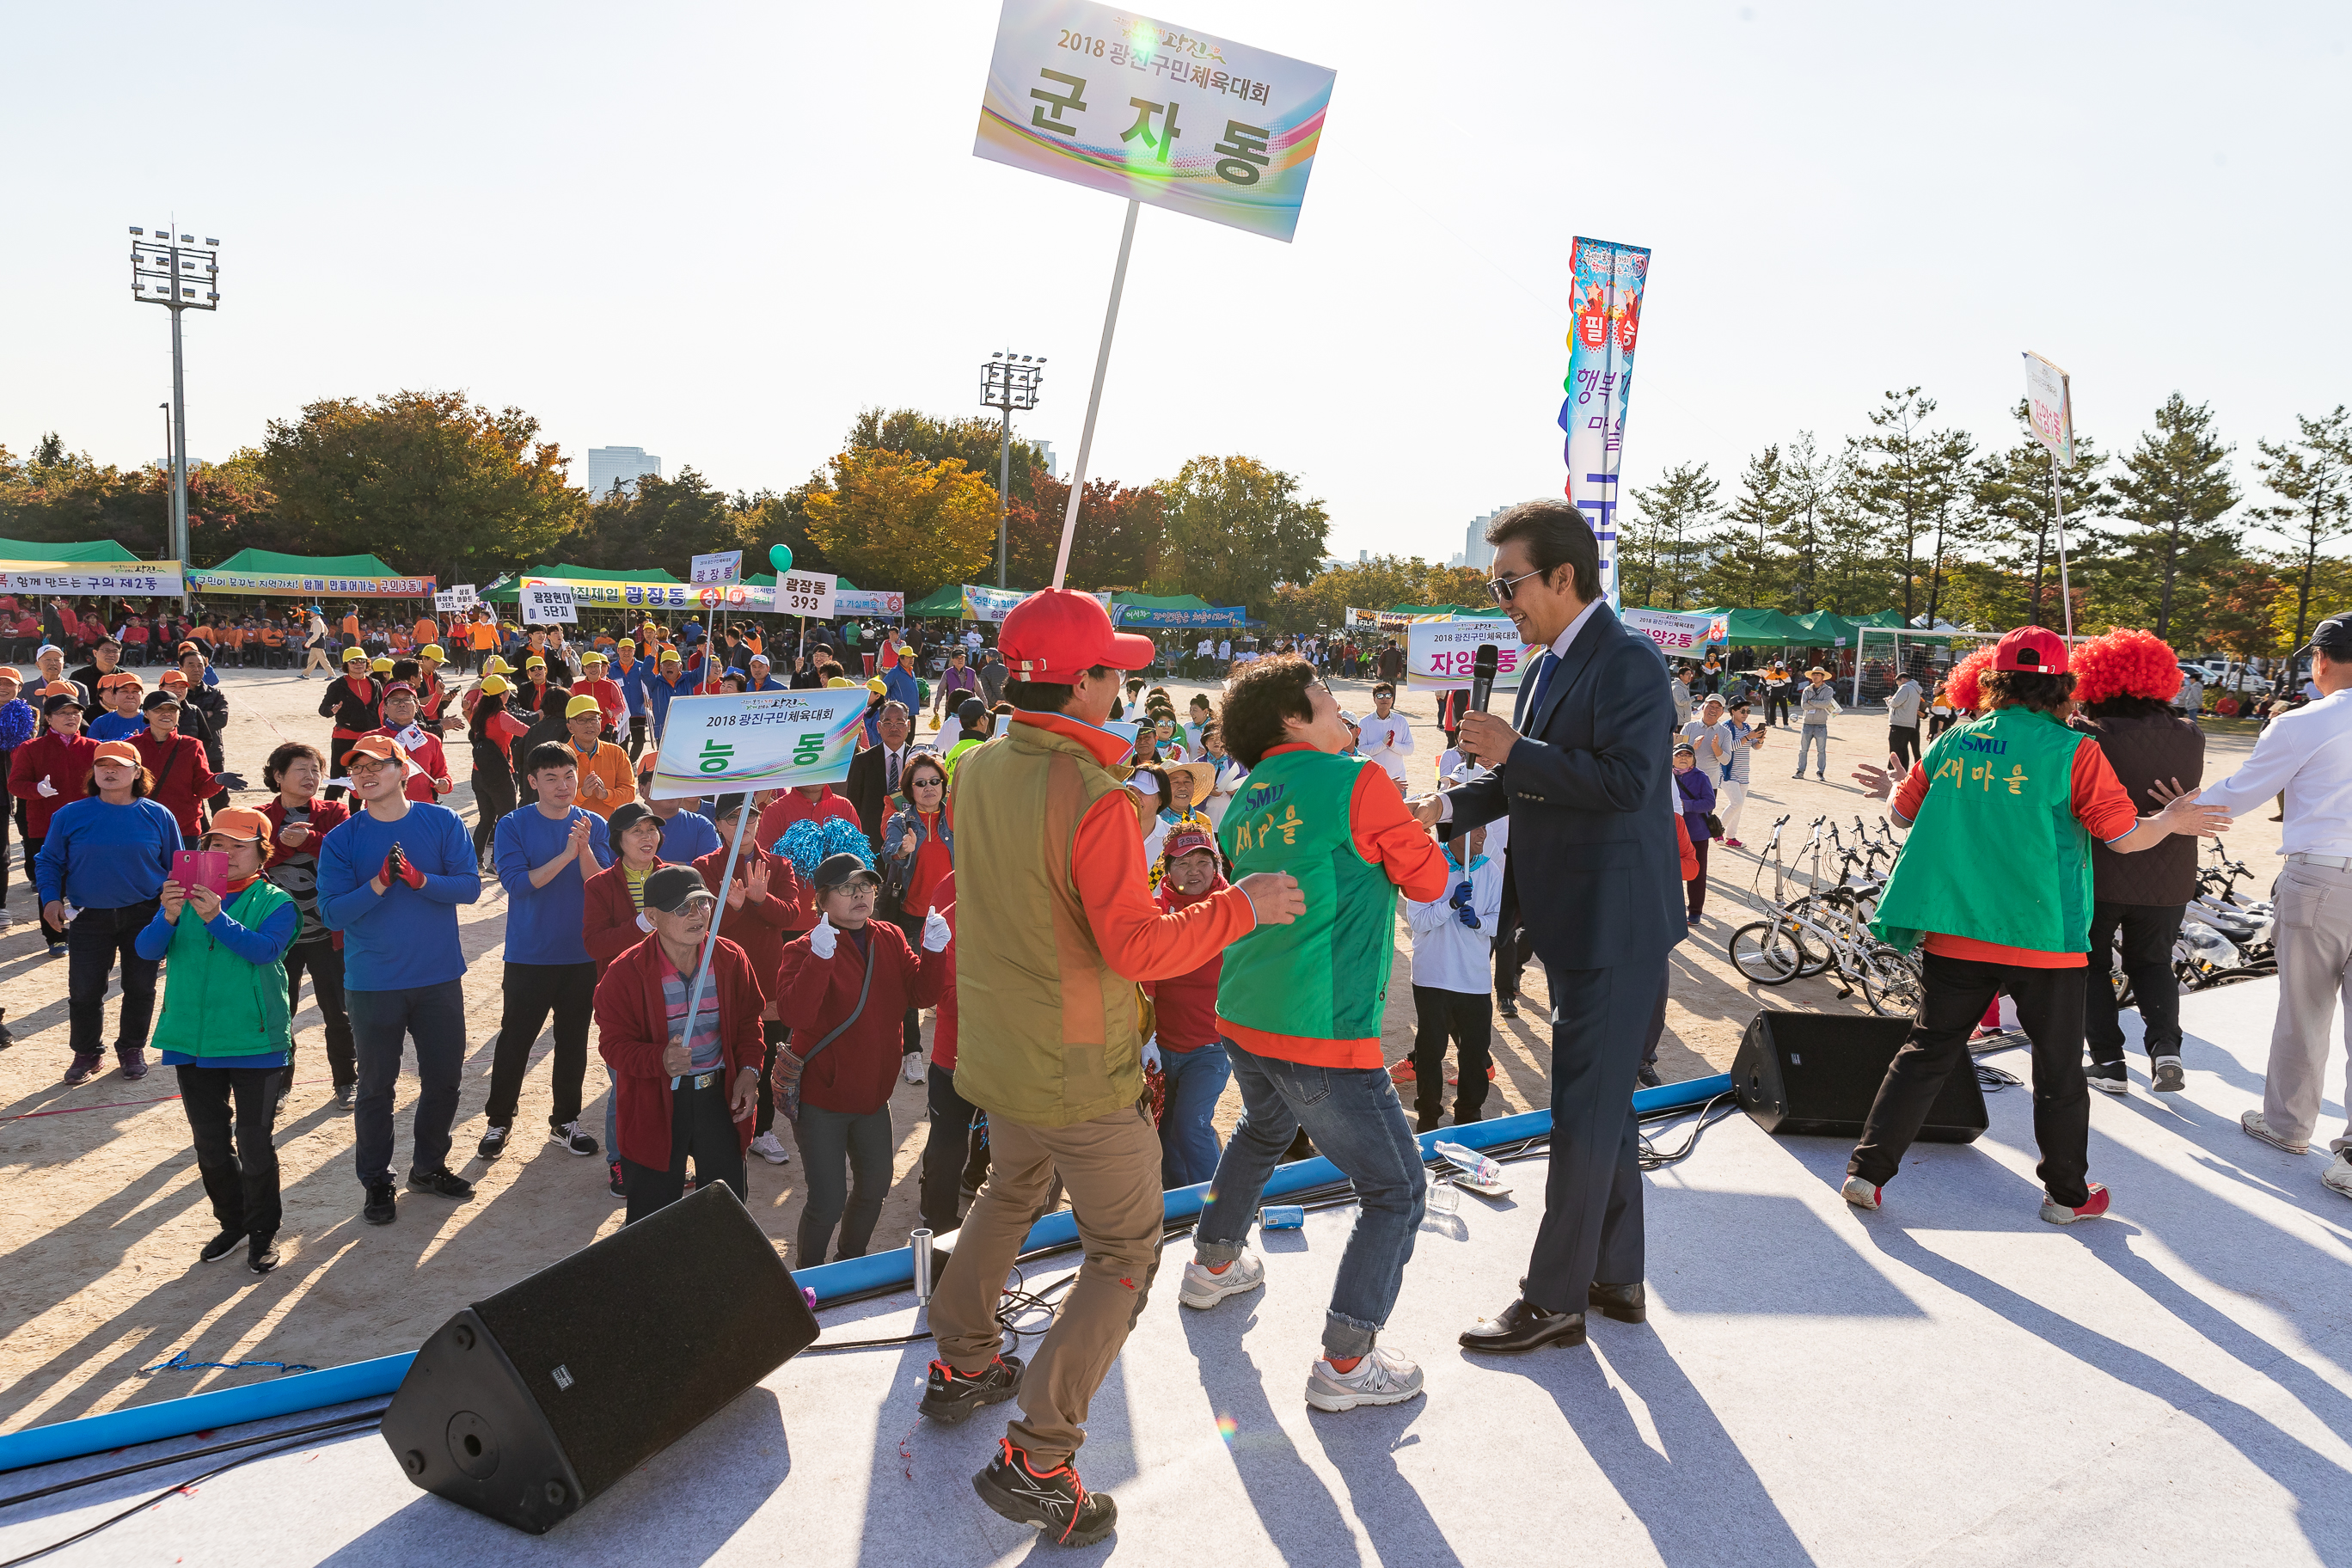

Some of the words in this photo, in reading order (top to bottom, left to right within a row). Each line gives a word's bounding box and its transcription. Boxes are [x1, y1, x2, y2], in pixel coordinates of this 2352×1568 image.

[1057, 29, 1105, 58] 2018
[1110, 40, 1271, 107] 광진구민체육대회
[1585, 315, 1603, 342] 필
[1623, 320, 1636, 346] 승
[16, 575, 41, 588] 함께
[45, 577, 82, 588] 만드는
[88, 577, 114, 590] 구의
[119, 577, 157, 591] 제2동
[198, 576, 226, 586] 구민이
[229, 577, 256, 588] 꿈꾸는
[259, 579, 299, 589] 지역가치!
[303, 579, 324, 591] 함께
[329, 579, 377, 591] 만들어가는
[380, 579, 422, 592] 구의3동!
[786, 577, 827, 596] 광장동
[533, 591, 572, 604] 광장현대
[625, 586, 686, 607] 광장동
[732, 591, 743, 603] 필
[754, 596, 770, 605] 우리
[790, 595, 818, 610] 393
[890, 595, 901, 610] 승
[543, 605, 569, 617] 5단지
[1652, 619, 1695, 630] 광진구민체육대회
[1454, 631, 1519, 642] 광진구민체육대회
[1430, 649, 1518, 676] 자양동
[706, 715, 736, 728] 2018
[738, 707, 835, 726] 광진구민체육대회
[698, 738, 735, 773] 능
[793, 732, 825, 766] 동
[1958, 735, 2008, 756] SMU
[1933, 756, 2029, 795] 새마을
[1245, 783, 1285, 811] SMU
[1235, 805, 1304, 857] 새마을
